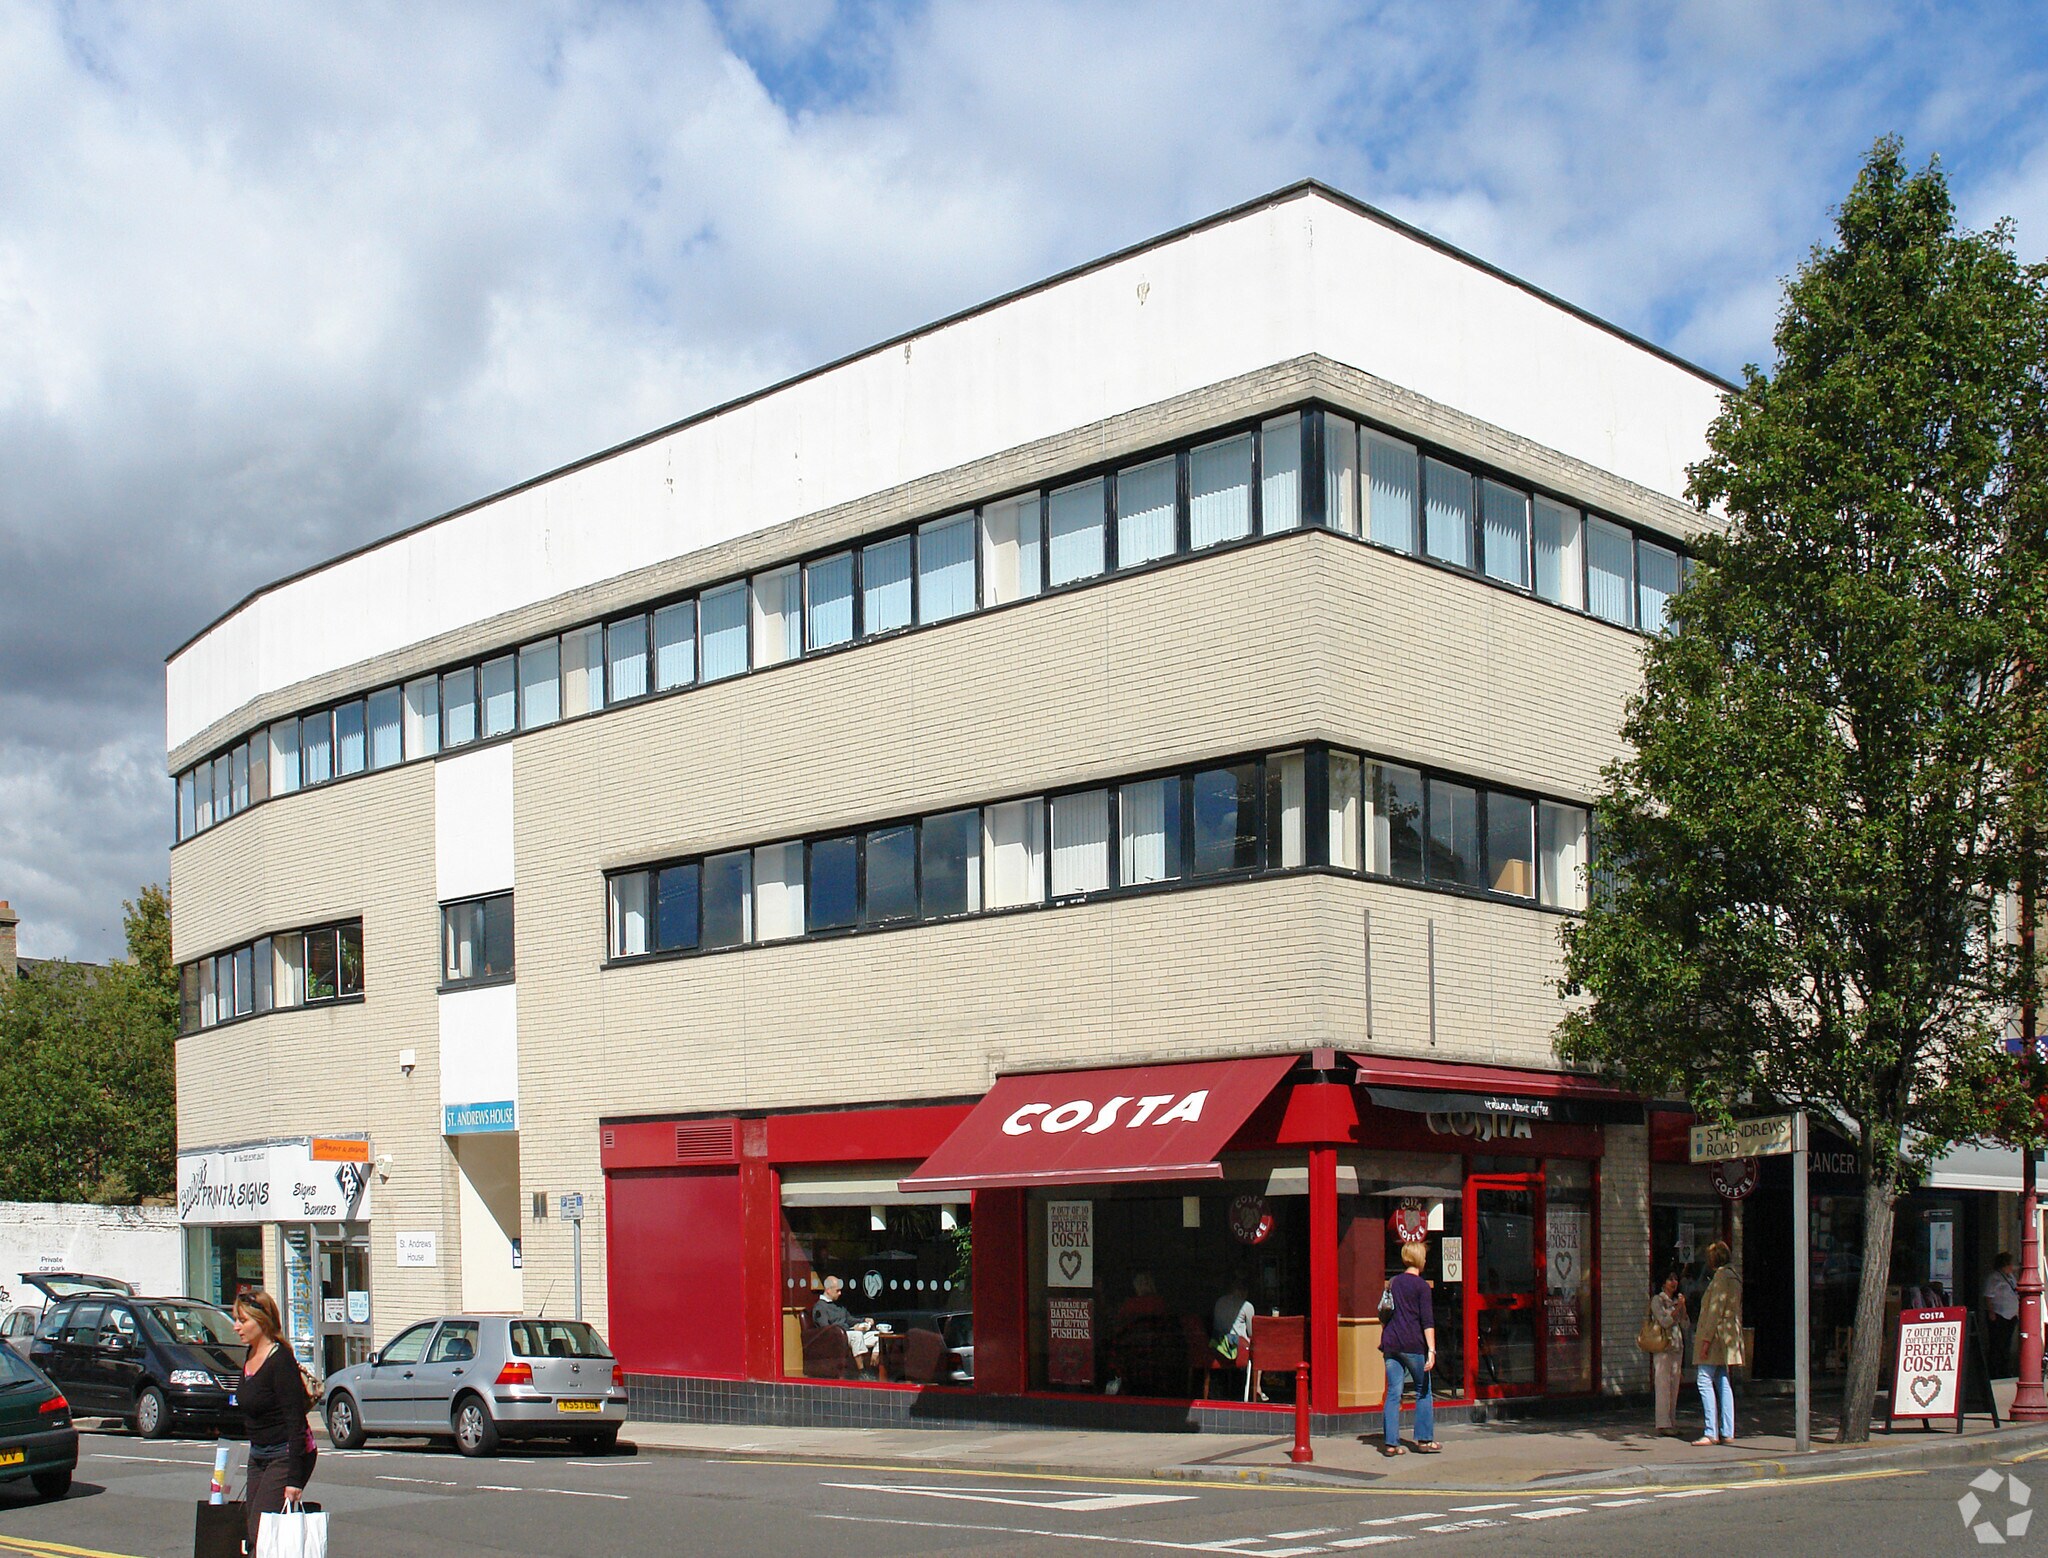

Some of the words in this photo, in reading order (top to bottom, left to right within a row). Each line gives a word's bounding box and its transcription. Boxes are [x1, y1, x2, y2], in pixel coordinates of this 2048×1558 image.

[1001, 1089, 1209, 1135] COSTA
[1512, 1098, 1529, 1113] about
[1531, 1101, 1549, 1117] coffee
[447, 1112, 457, 1126] ST.
[457, 1109, 489, 1126] ANDREWS
[490, 1107, 513, 1123] HOUSE
[1707, 1130, 1720, 1142] ST
[1727, 1120, 1787, 1139] ANDREWS
[1706, 1142, 1740, 1157] ROAD
[293, 1182, 317, 1201] Signs
[1715, 1176, 1753, 1197] COFFEE
[202, 1184, 229, 1210] PRINT
[228, 1182, 237, 1210] &
[237, 1182, 270, 1211] SIGNS
[304, 1202, 337, 1216] Banners
[1052, 1221, 1089, 1232] PREFER
[1233, 1222, 1267, 1240] COFFEE
[1398, 1224, 1425, 1242] COFFEE
[408, 1239, 432, 1248] Andrews
[407, 1252, 425, 1262] House
[1050, 1308, 1091, 1320] BARISTAS,
[1919, 1312, 1945, 1320] COSTA
[1050, 1319, 1062, 1328] NOT
[1063, 1319, 1089, 1328] BUTTON
[1905, 1336, 1929, 1344] COFFEE
[1930, 1335, 1957, 1344] LOVERS
[1906, 1329, 1912, 1338] 7
[1914, 1328, 1932, 1337] OUT
[1933, 1327, 1946, 1337] OF
[1947, 1327, 1957, 1336] 10
[1905, 1343, 1955, 1356] PREFER
